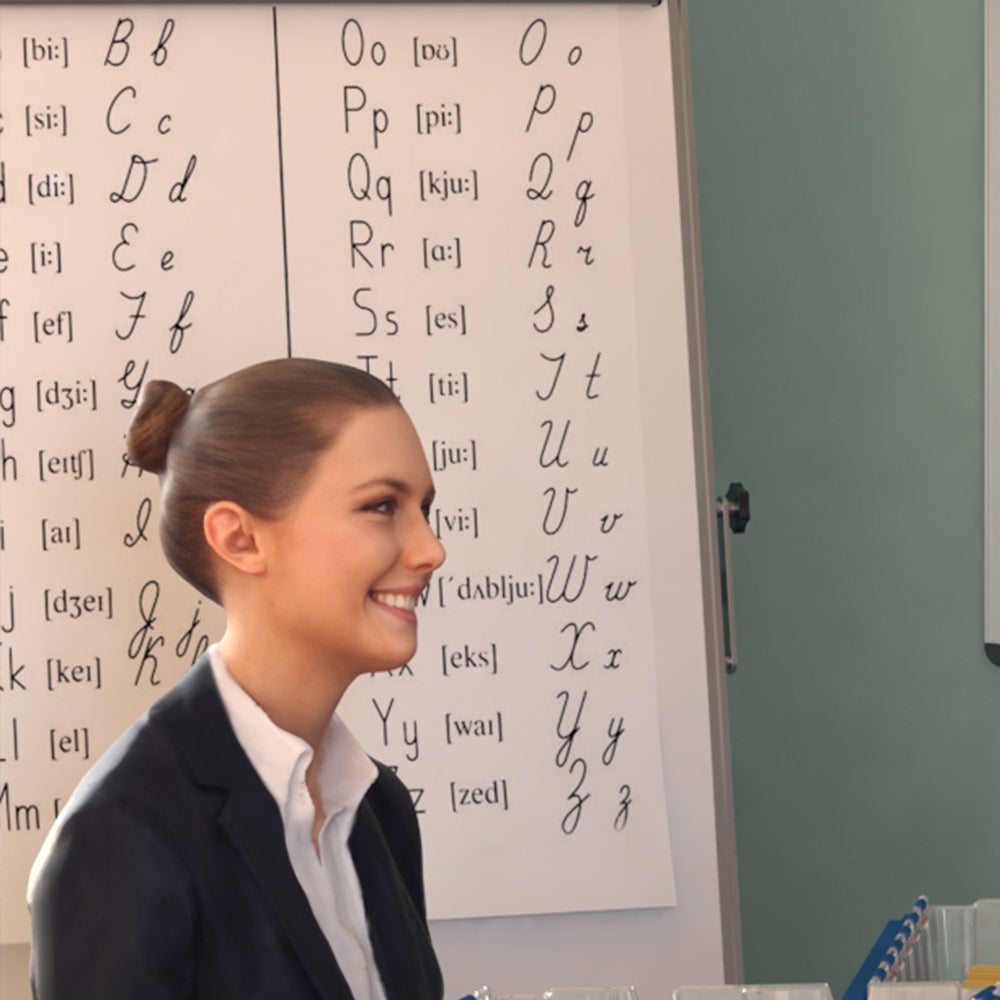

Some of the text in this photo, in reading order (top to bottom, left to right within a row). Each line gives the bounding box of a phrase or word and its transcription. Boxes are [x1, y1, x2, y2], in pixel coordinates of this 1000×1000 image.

[341, 18, 386, 66] Oo
[343, 85, 389, 149] Pp
[347, 153, 392, 216] Qq
[349, 220, 394, 268] Rr
[353, 287, 399, 337] Ss
[372, 698, 419, 761] Yy
